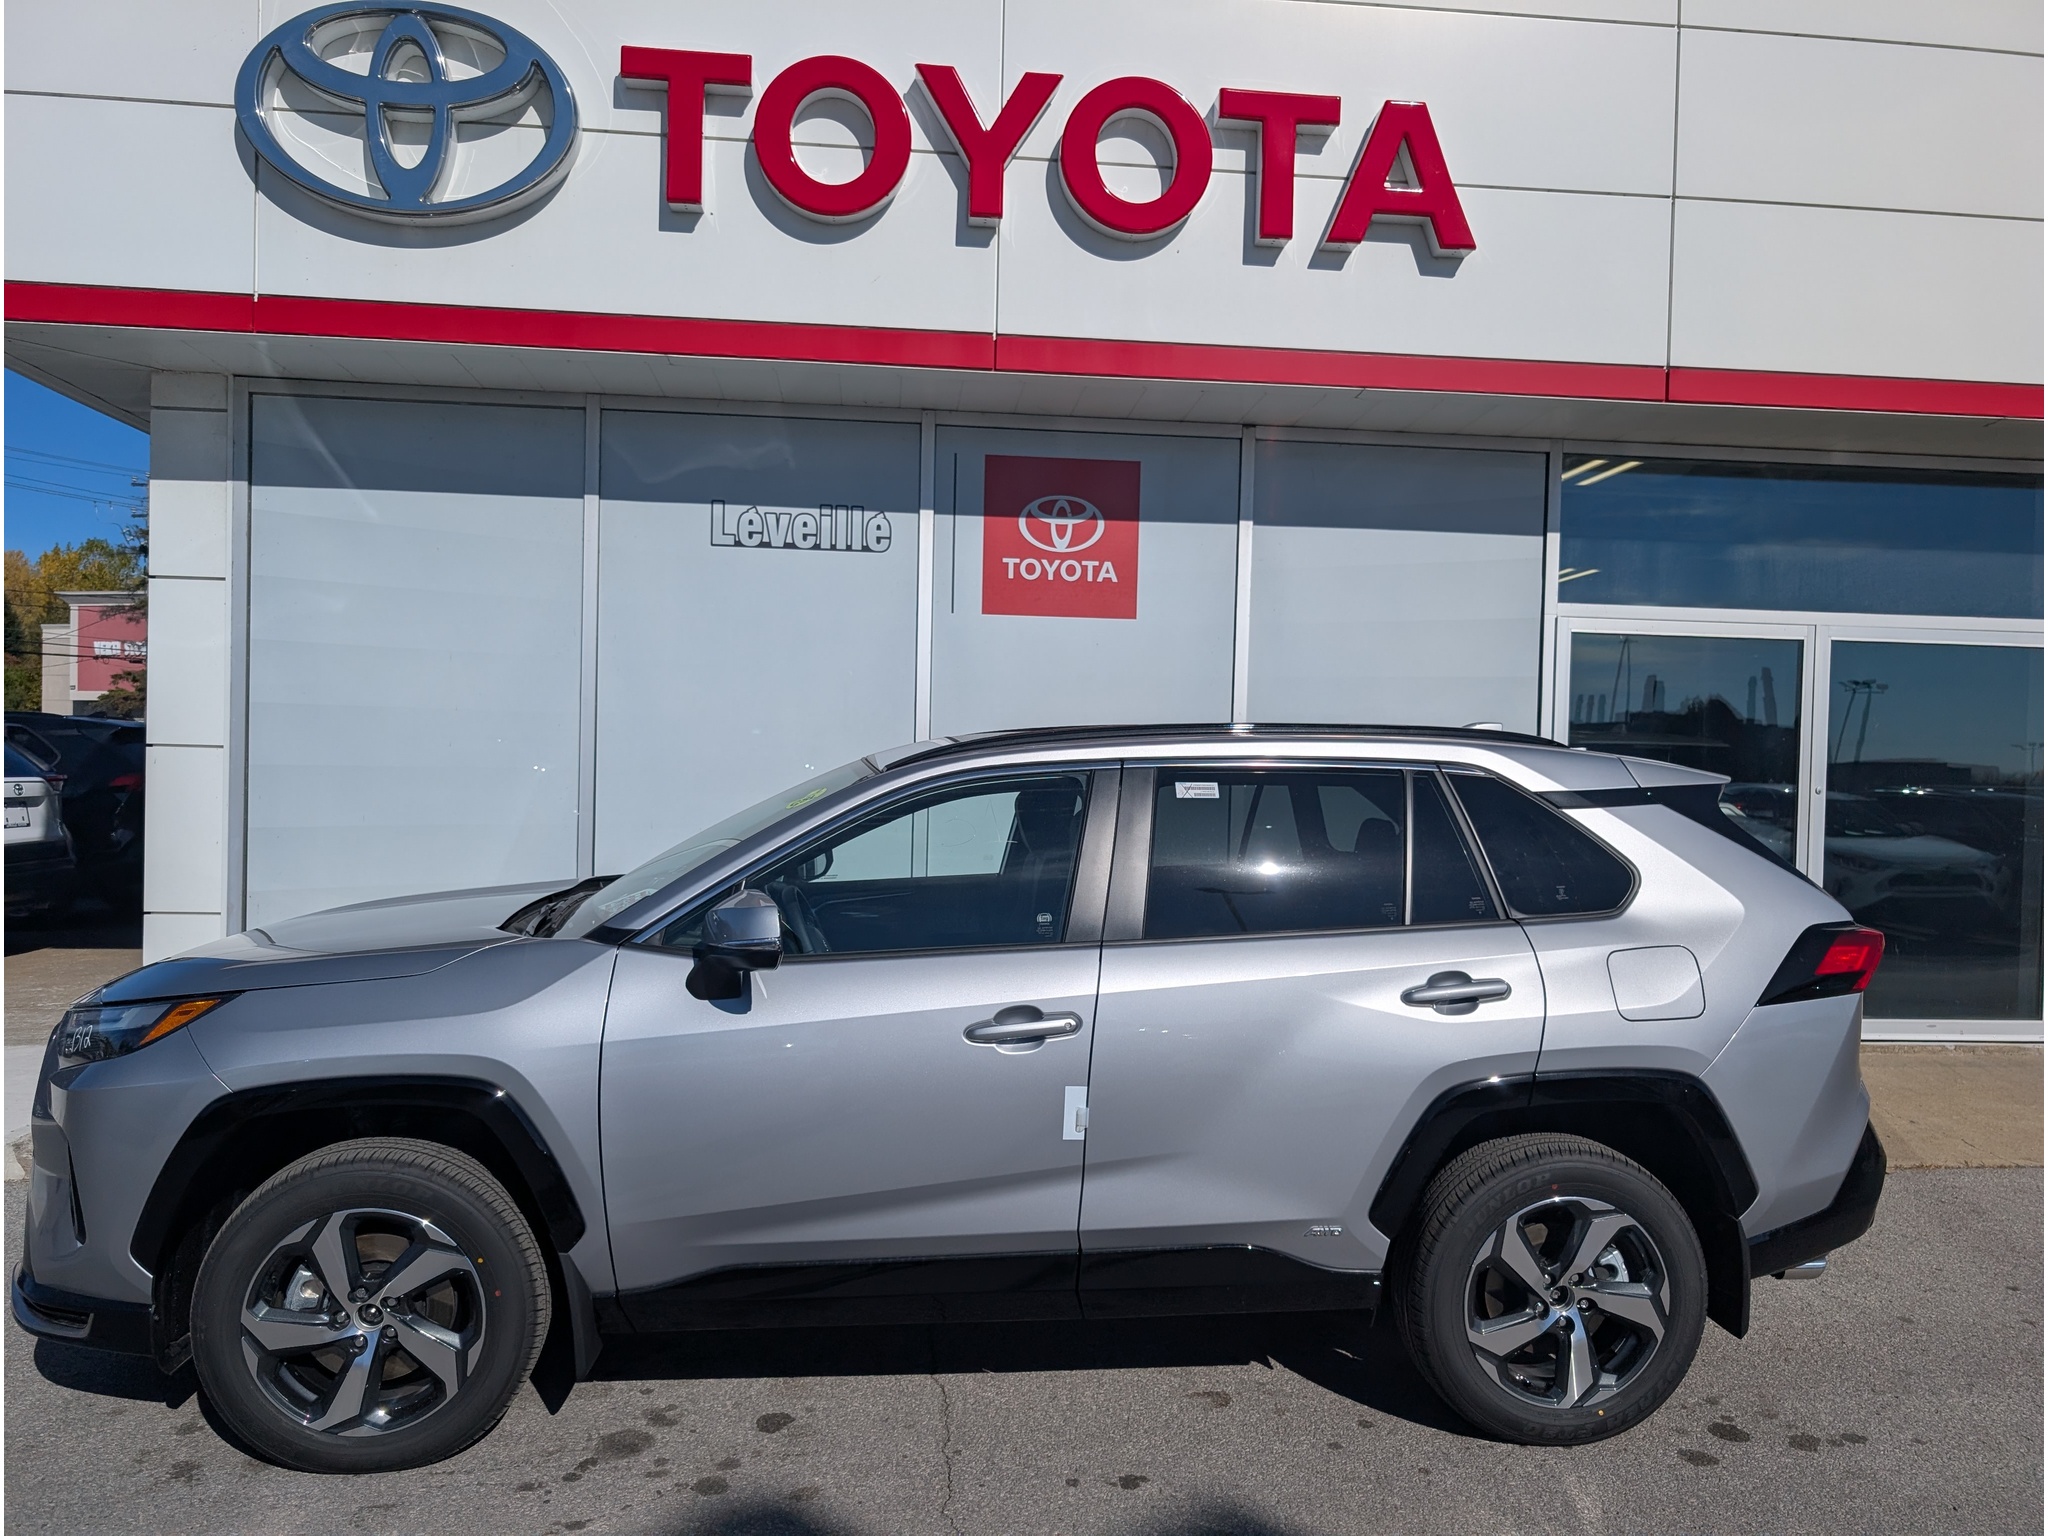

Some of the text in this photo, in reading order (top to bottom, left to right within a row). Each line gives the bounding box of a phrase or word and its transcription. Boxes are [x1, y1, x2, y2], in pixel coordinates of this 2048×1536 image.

[620, 45, 1476, 256] TOYOTA
[711, 500, 892, 553] Léveillé
[1002, 557, 1119, 583] TOYOTA
